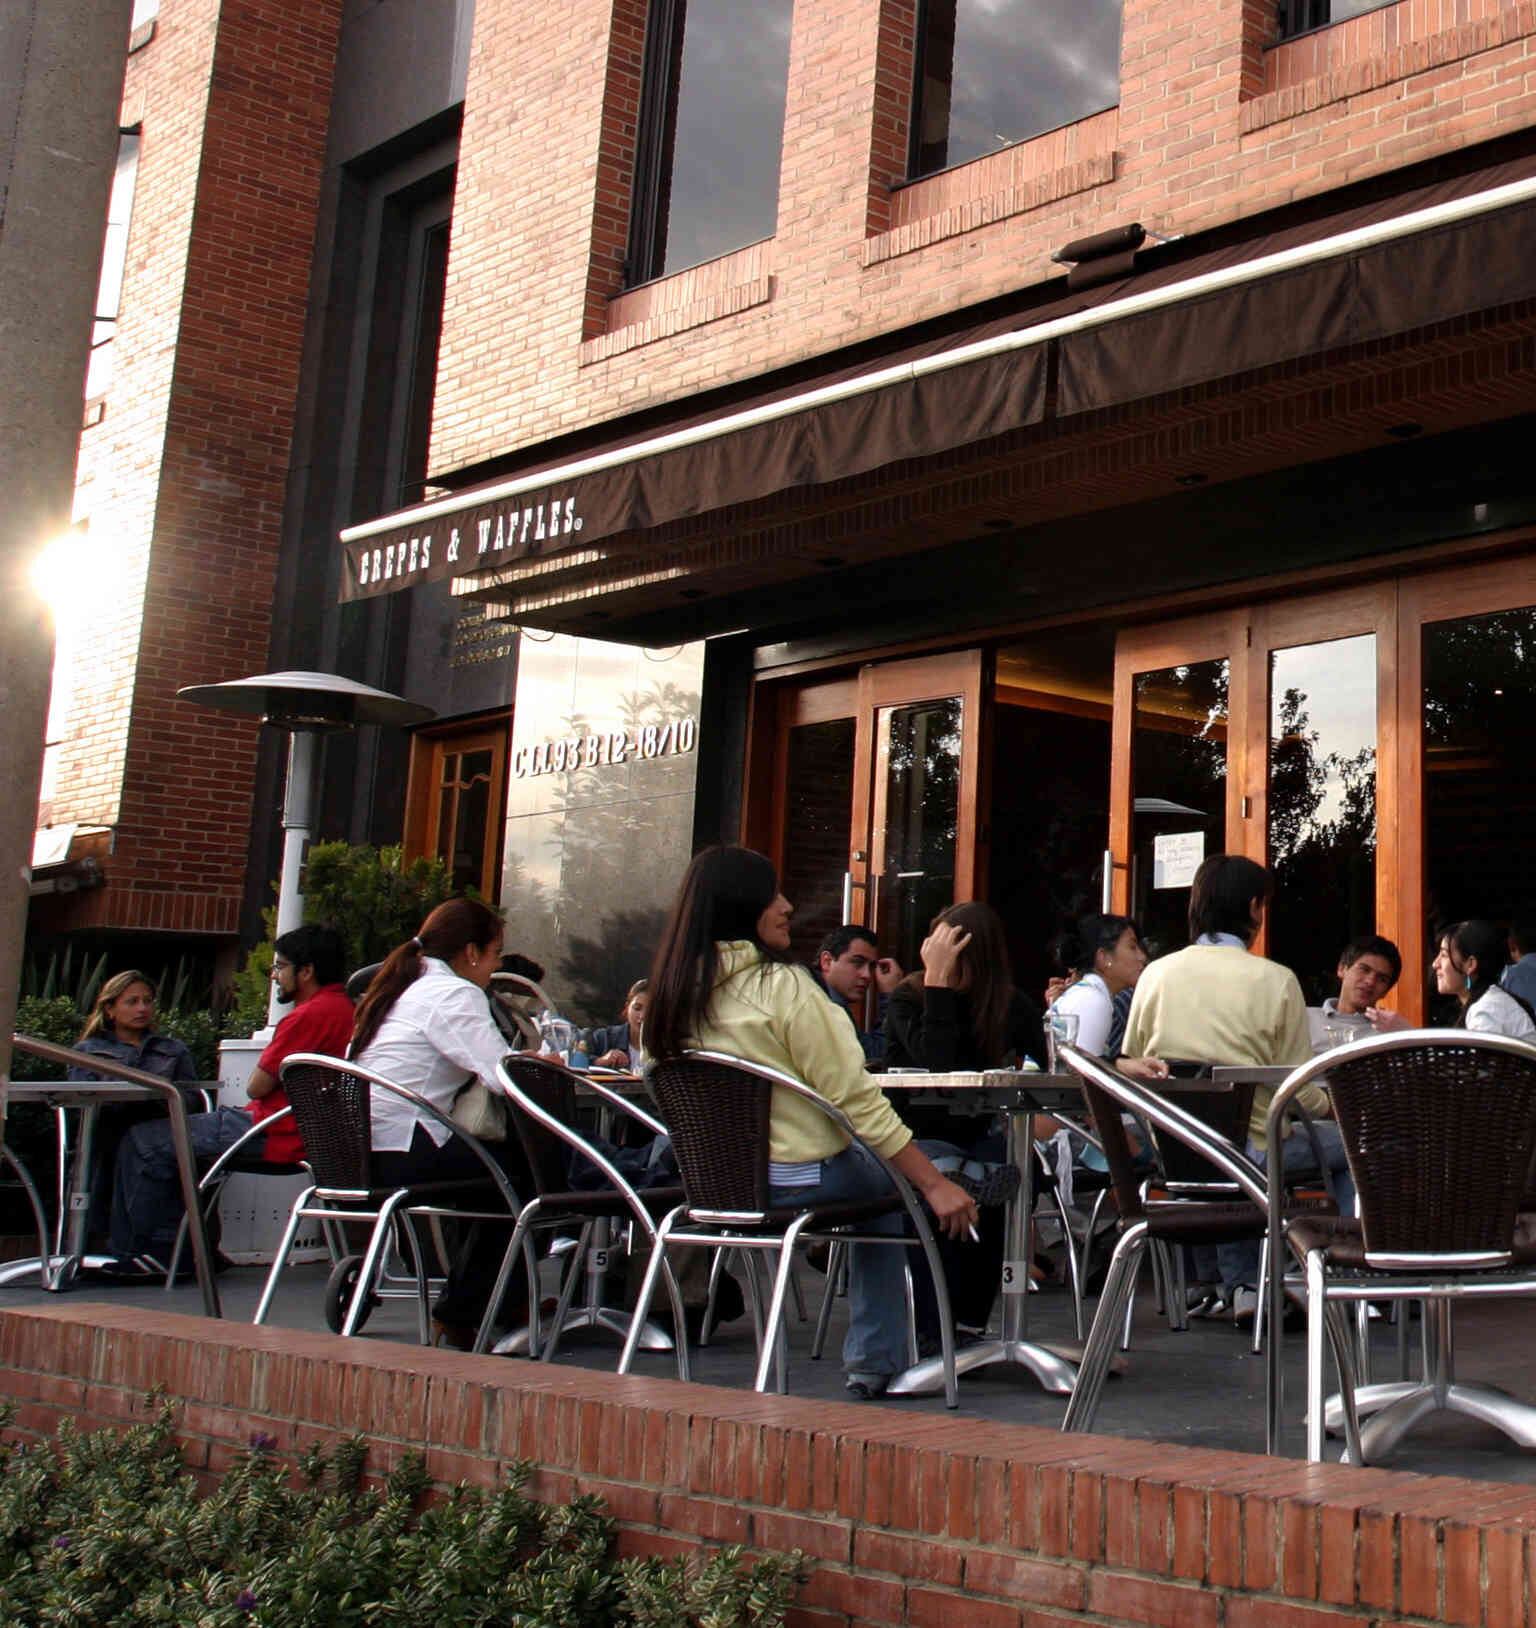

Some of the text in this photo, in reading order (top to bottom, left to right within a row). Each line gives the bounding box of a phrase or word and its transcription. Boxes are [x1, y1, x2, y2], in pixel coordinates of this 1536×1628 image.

[359, 535, 432, 585] CREPES
[447, 528, 460, 562] &
[596, 1251, 607, 1266] 5
[1003, 1266, 1013, 1284] 3
